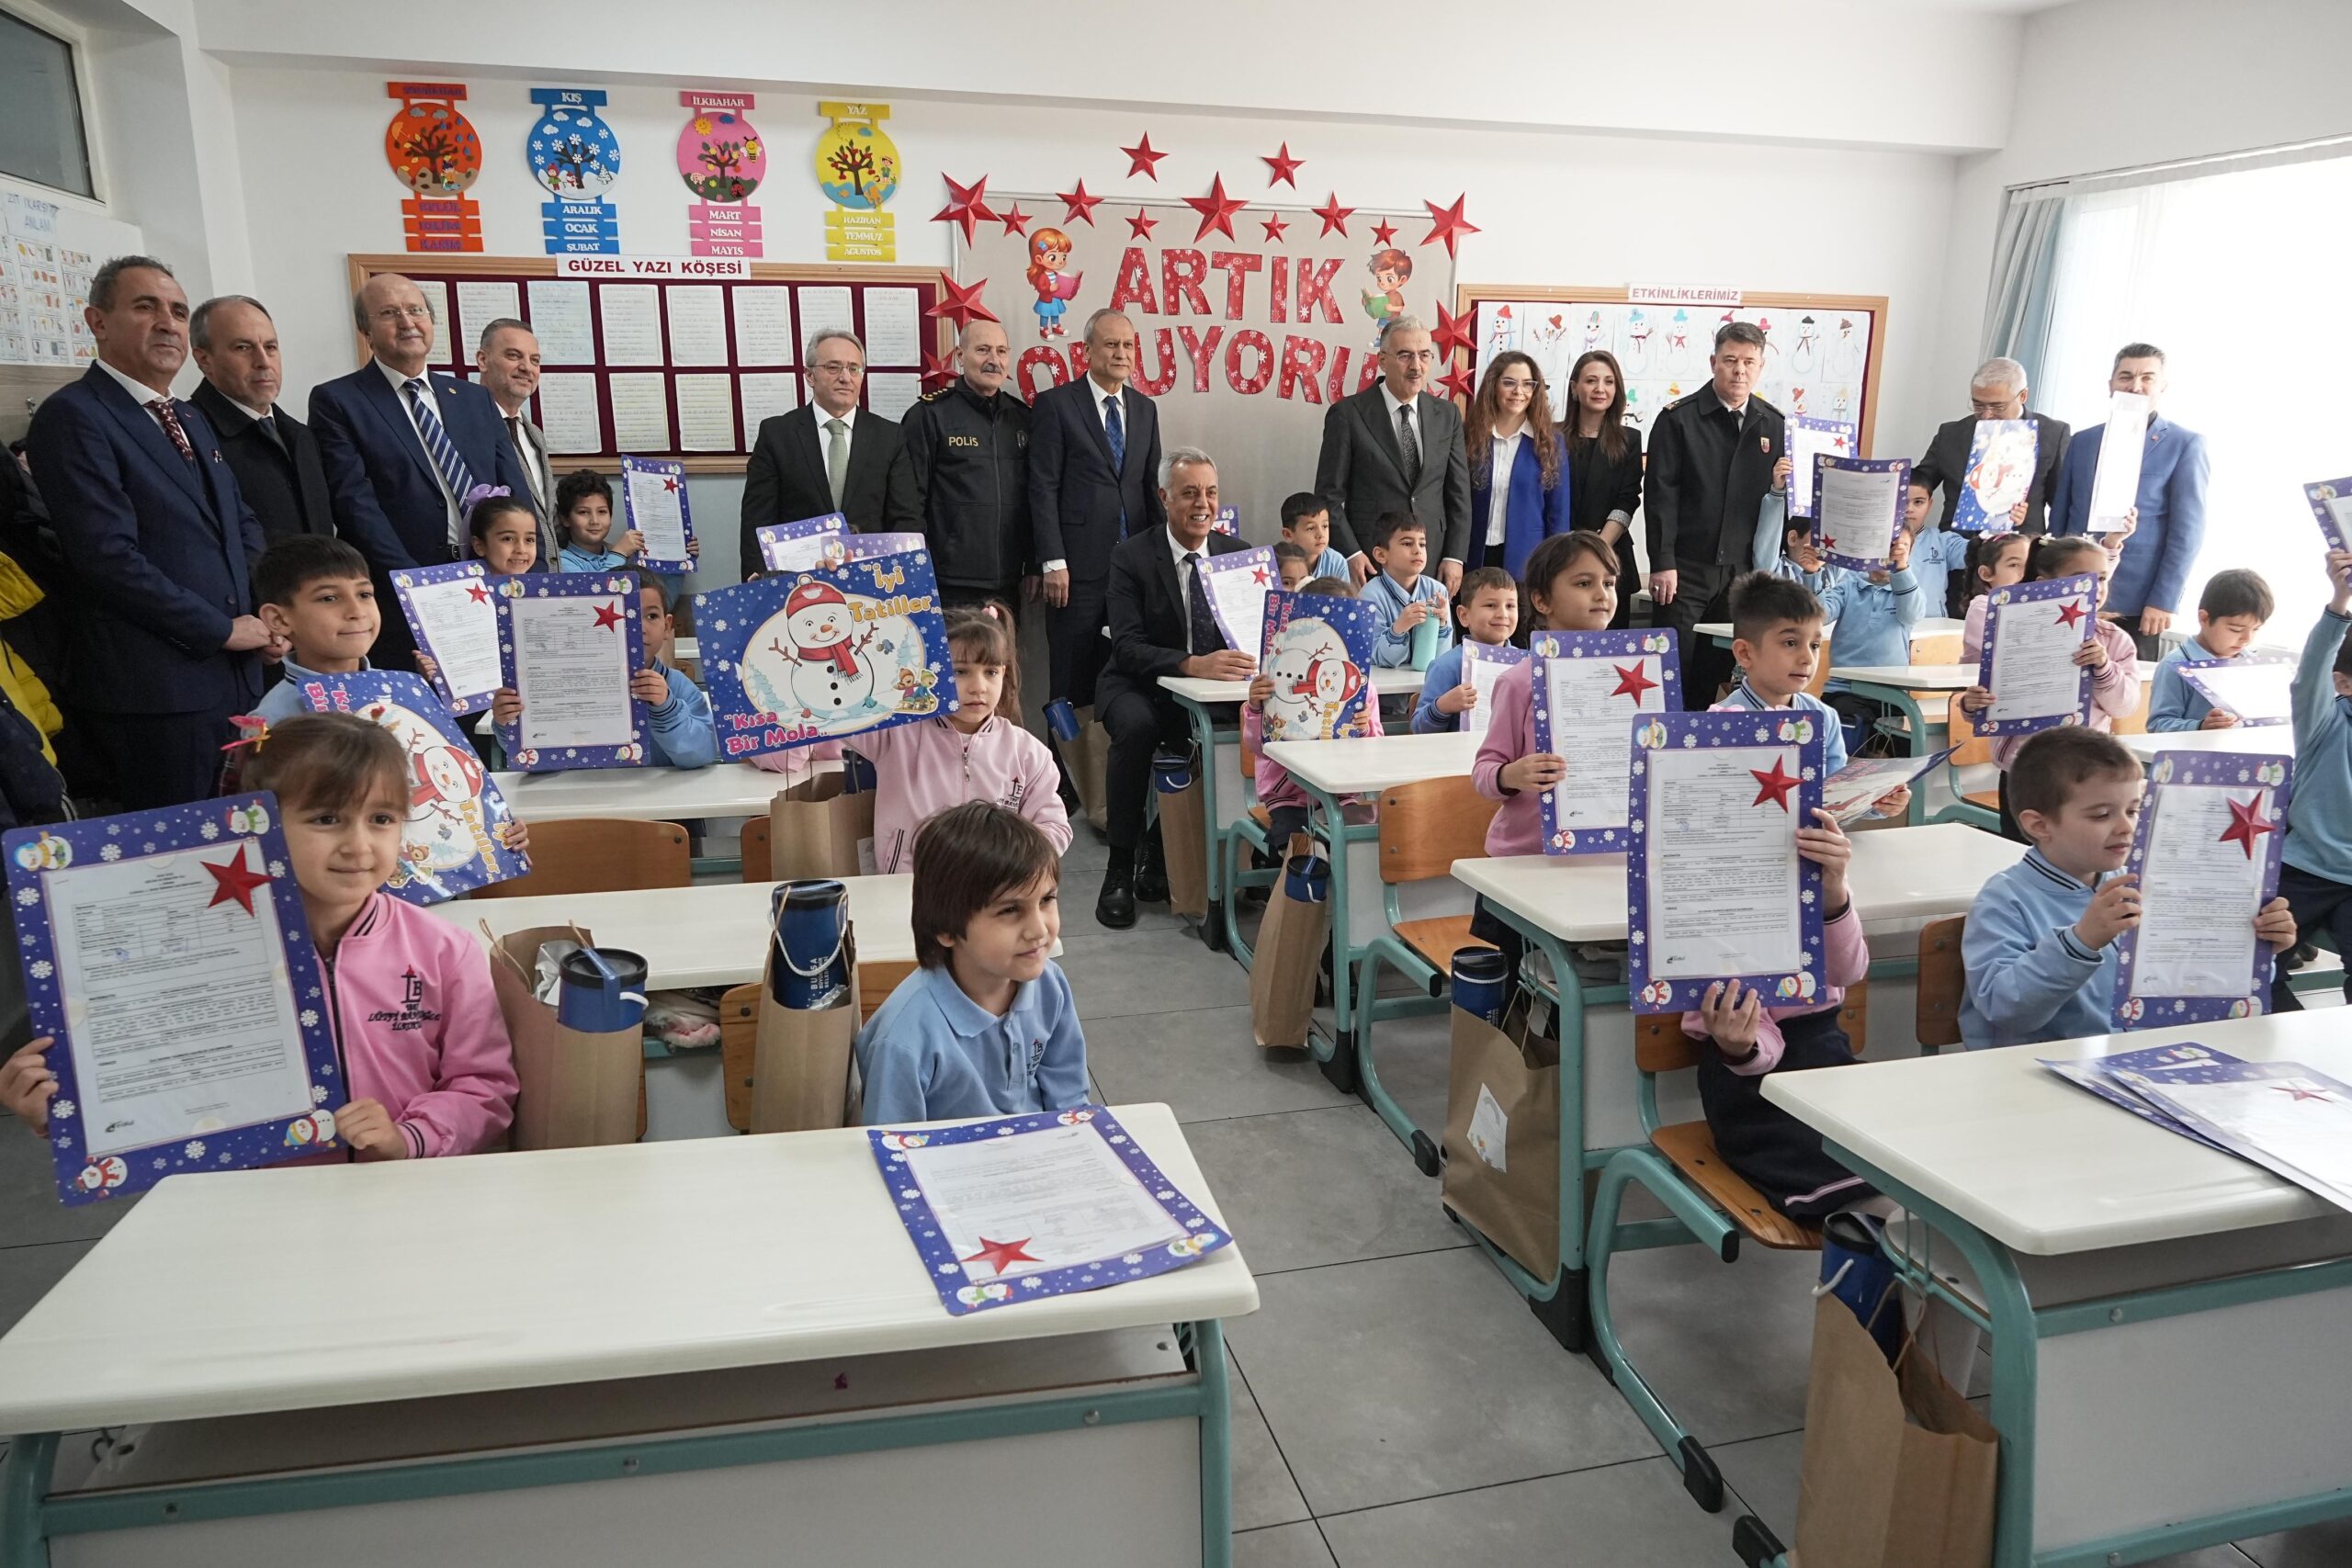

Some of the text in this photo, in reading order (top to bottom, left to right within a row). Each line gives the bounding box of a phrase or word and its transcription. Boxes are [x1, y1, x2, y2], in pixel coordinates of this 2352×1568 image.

[561, 92, 582, 105] KIŞ
[692, 96, 745, 107] İLKBAHAR
[847, 106, 867, 116] YAZ
[562, 205, 603, 215] ARALIK
[709, 210, 741, 220] MART
[564, 223, 599, 233] OCAK
[710, 227, 742, 237] NİSAN
[844, 232, 883, 242] TEMMUZ
[566, 243, 600, 252] ŞUBAT
[711, 246, 744, 255] MAYIS
[568, 258, 742, 276] GÜZEL YAZI KÖŞESİ
[1109, 247, 1346, 325] ARTIK
[1632, 286, 1738, 301] ETKİNLİKLERİMİZ
[1263, 593, 1280, 655] Bir Mola
[725, 735, 759, 754] Bir
[809, 958, 819, 990] BUSA
